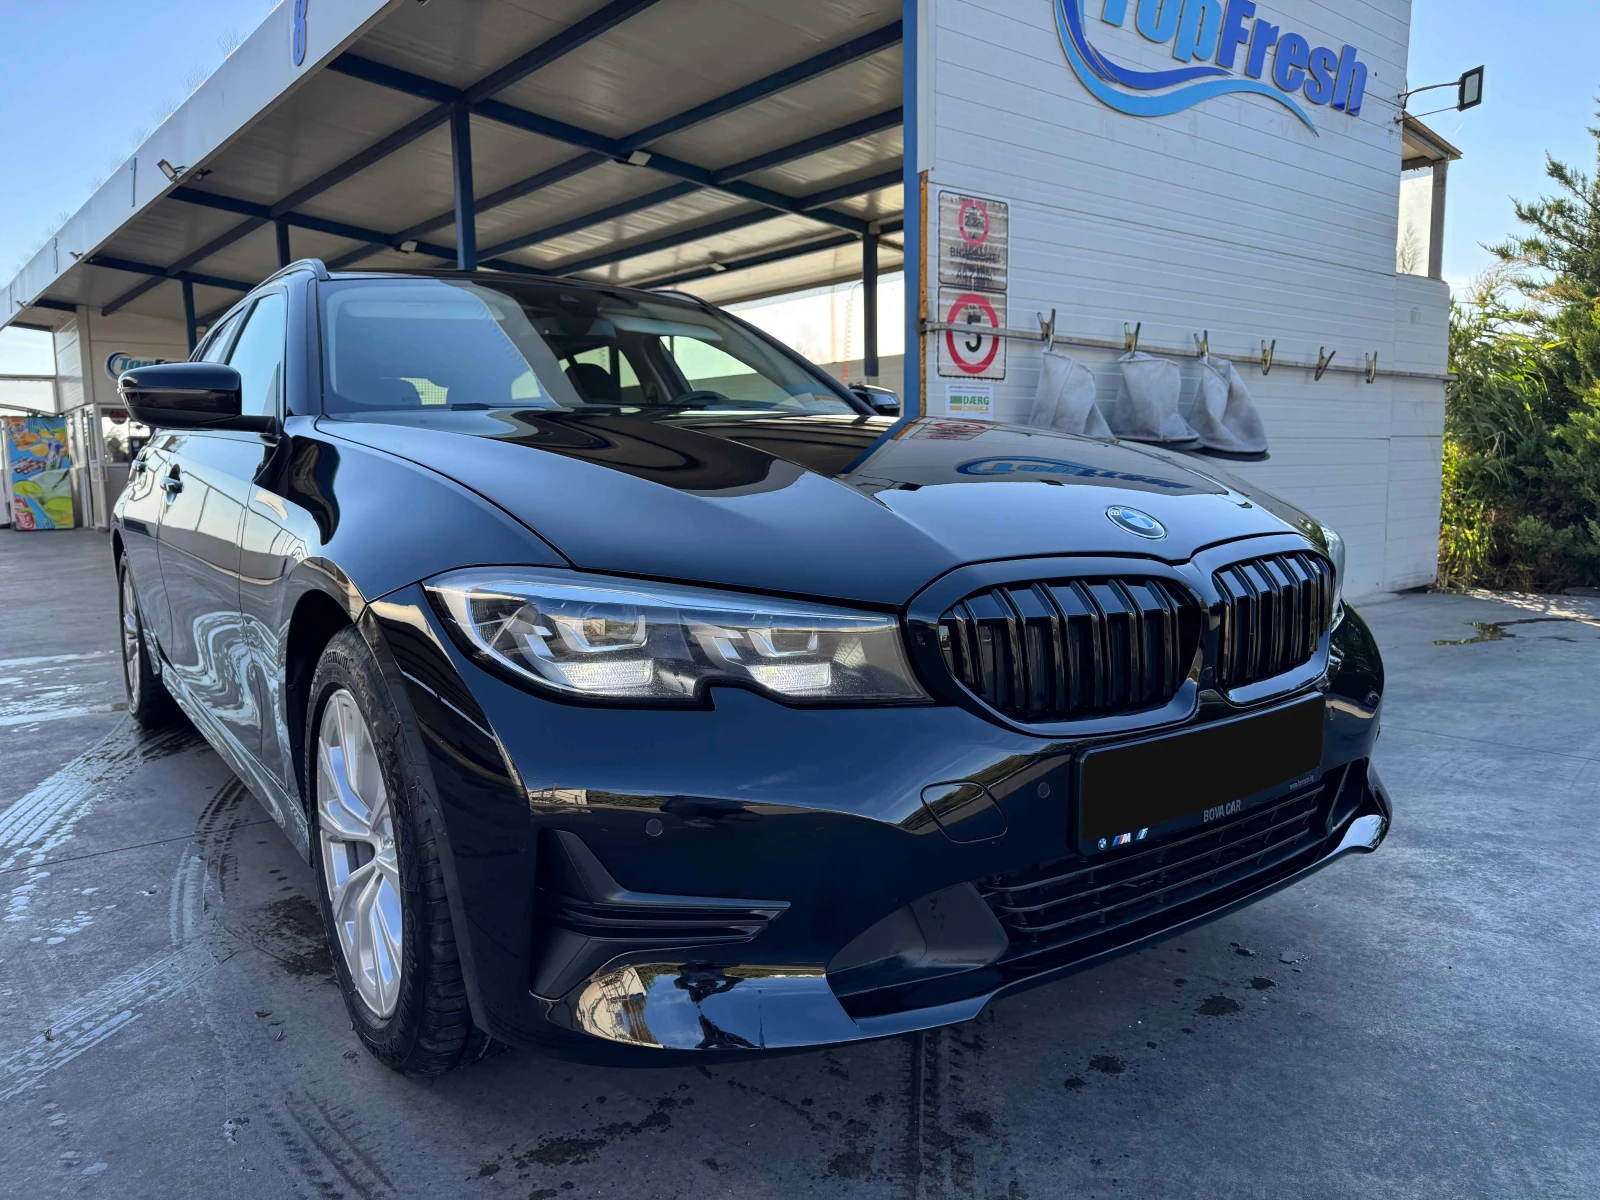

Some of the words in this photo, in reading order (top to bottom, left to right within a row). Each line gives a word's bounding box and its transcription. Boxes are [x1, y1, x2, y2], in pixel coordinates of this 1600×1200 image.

[964, 314, 982, 353] 5
[1203, 804, 1225, 823] BOVA
[1225, 799, 1242, 815] CAR
